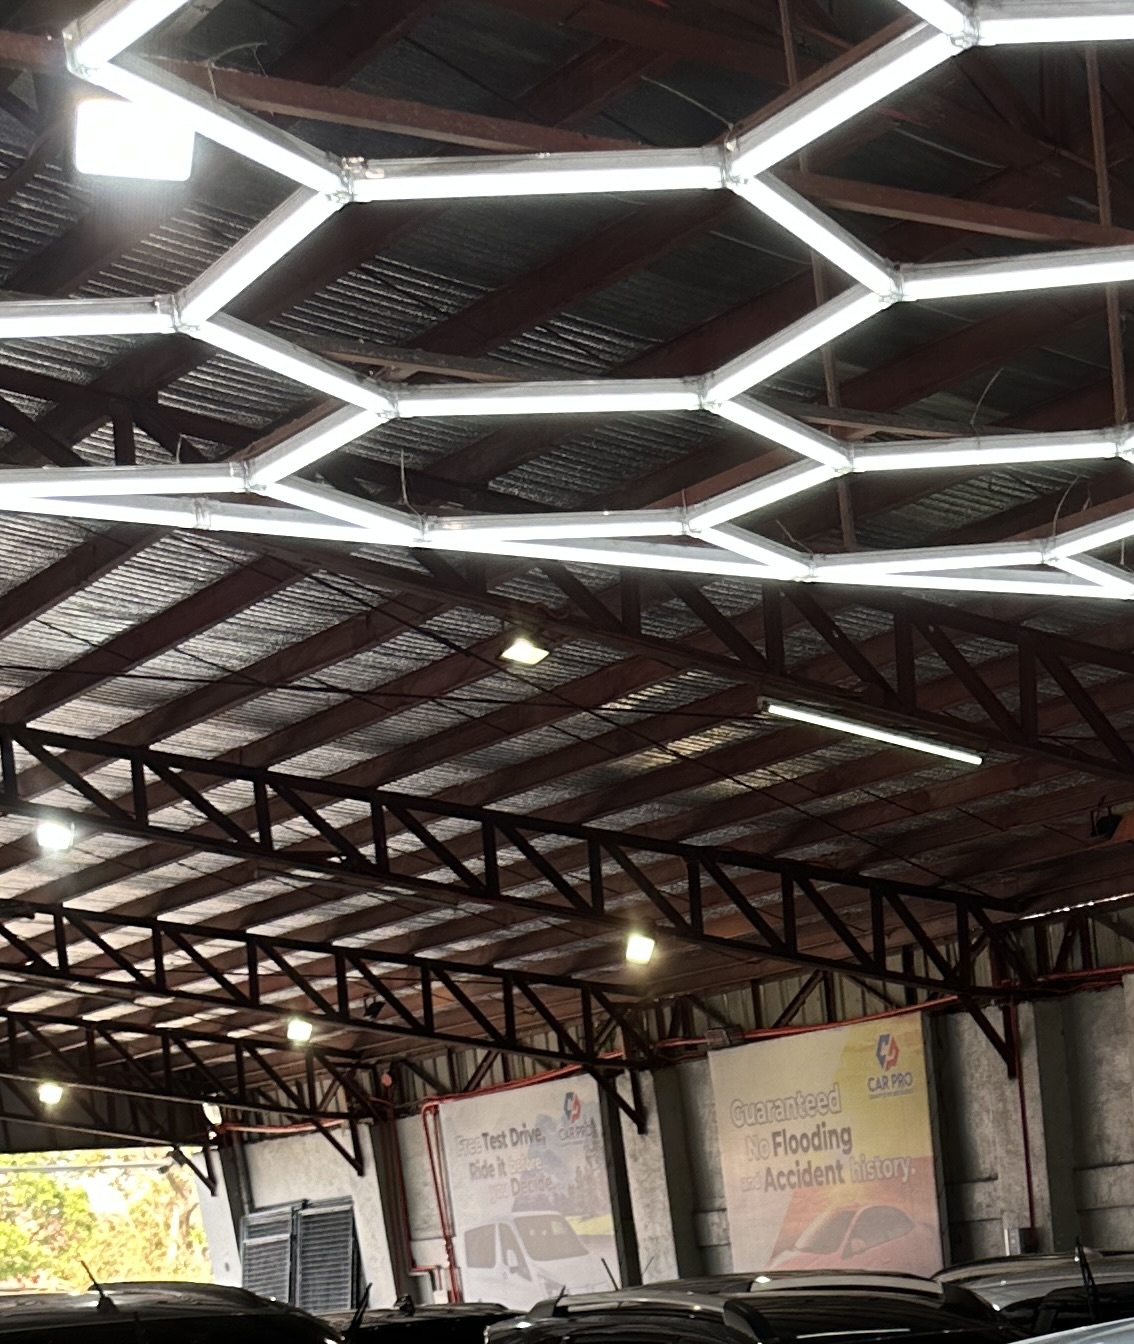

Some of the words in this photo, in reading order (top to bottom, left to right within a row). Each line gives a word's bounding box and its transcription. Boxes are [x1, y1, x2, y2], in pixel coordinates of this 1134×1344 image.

[867, 1076, 889, 1092] CAR
[891, 1071, 913, 1089] PRO
[730, 1081, 842, 1129] Guaranteed
[481, 1130, 508, 1151] Test
[509, 1122, 546, 1147] Drive,
[745, 1134, 771, 1162] No
[772, 1121, 853, 1157] Flooding
[469, 1159, 495, 1181] Ride
[497, 1155, 507, 1177] it
[764, 1159, 846, 1193] Accident
[851, 1153, 916, 1184] history.
